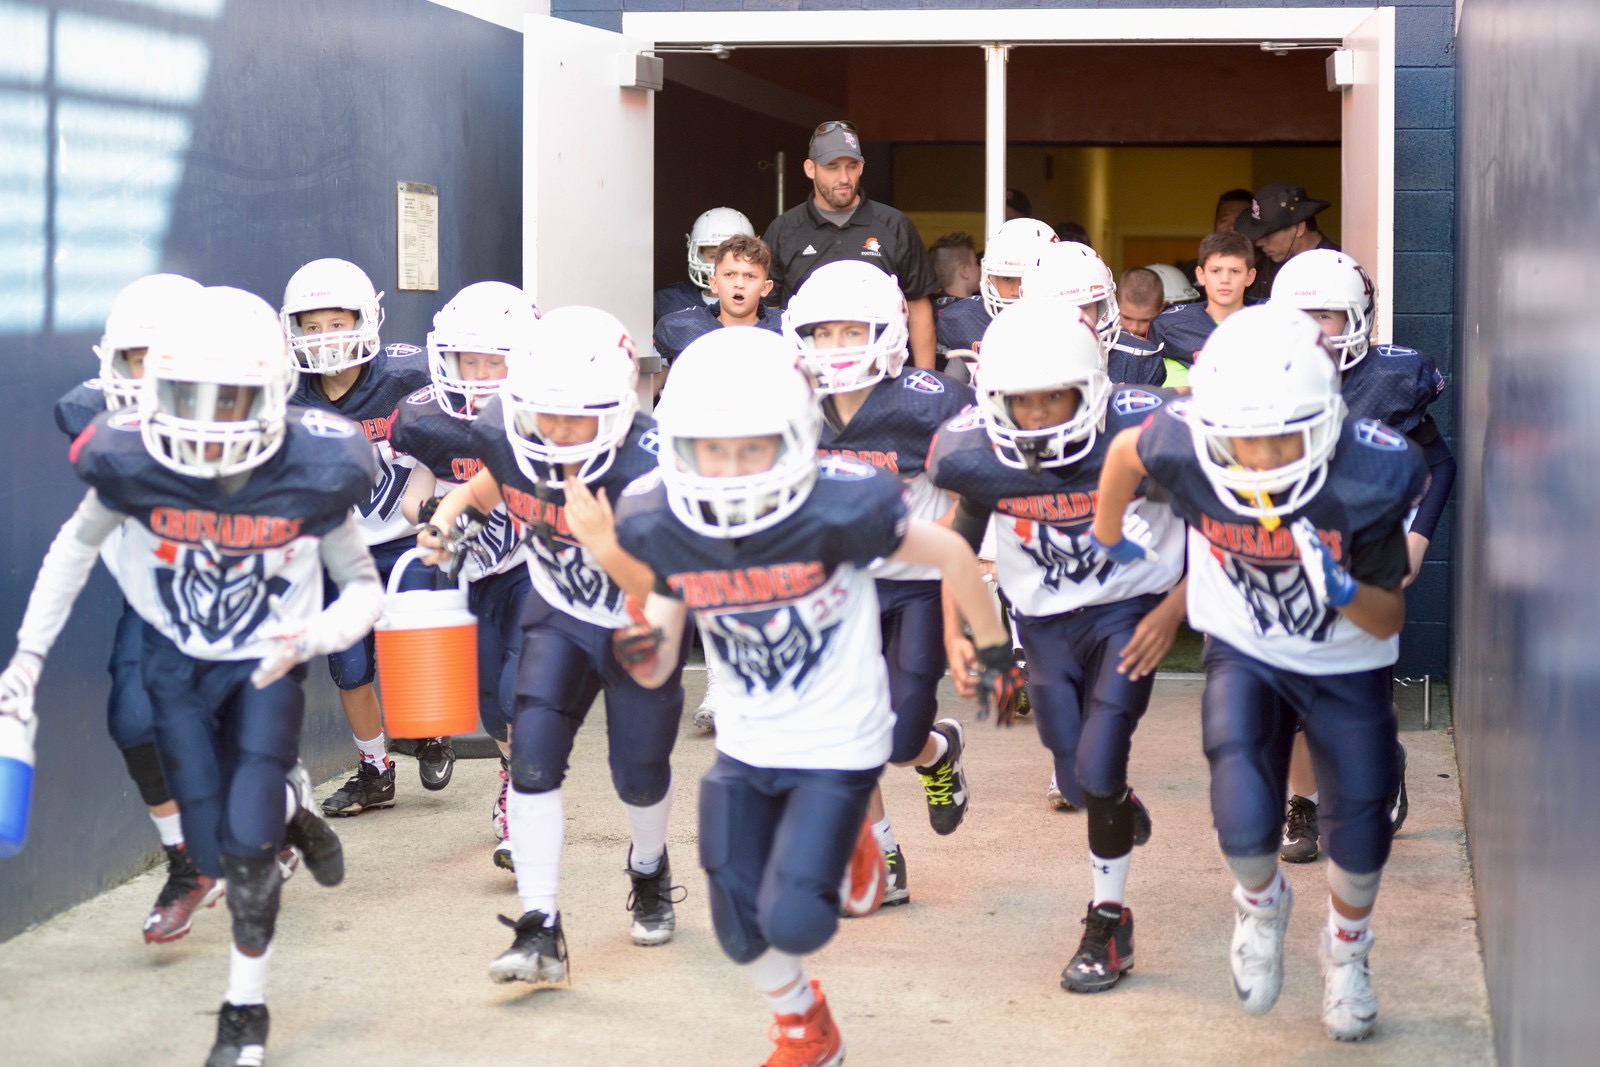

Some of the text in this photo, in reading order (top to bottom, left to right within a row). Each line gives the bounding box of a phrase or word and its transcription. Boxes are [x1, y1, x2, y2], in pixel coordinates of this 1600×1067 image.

[151, 506, 304, 548] CRUSADERS
[997, 490, 1100, 522] CRUSAD
[666, 560, 826, 609] CRUSADERS
